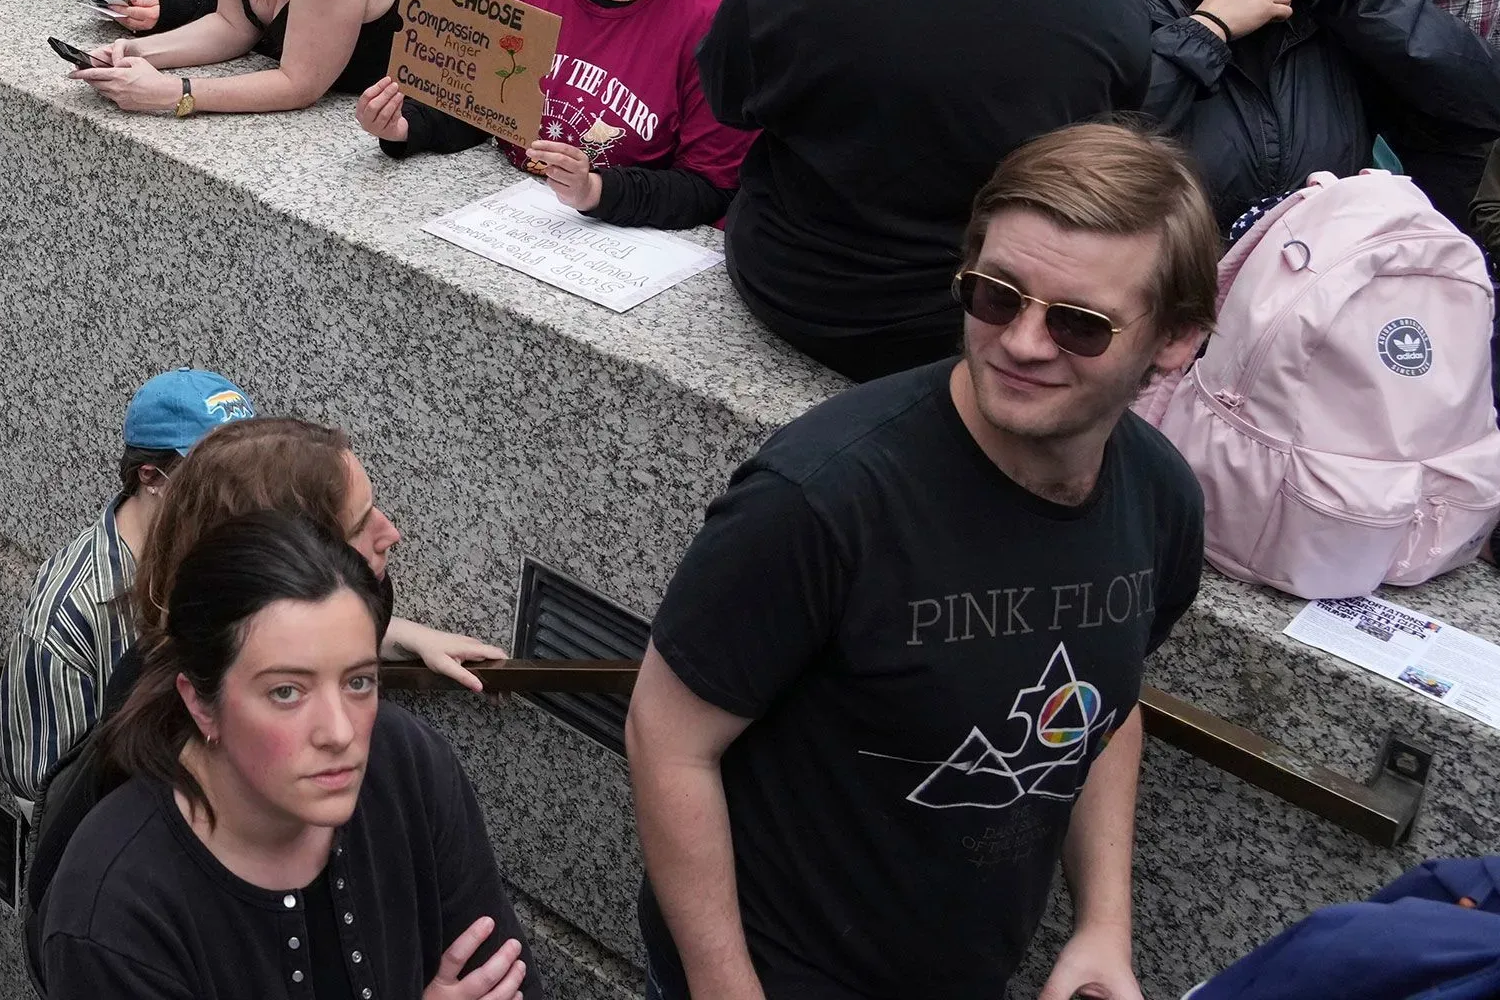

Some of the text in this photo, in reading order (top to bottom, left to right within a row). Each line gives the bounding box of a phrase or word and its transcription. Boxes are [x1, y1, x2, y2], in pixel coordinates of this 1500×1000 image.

[406, 0, 491, 50] Compassion
[404, 28, 478, 81] Presence
[444, 34, 483, 59] Anger
[397, 65, 462, 104] Conscious
[439, 68, 475, 95] Panic
[569, 57, 609, 97] THE
[604, 77, 660, 142] STARS
[1395, 351, 1425, 361] adidas
[906, 586, 1036, 646] PINK
[1315, 601, 1355, 622] TRUMP!
[1359, 614, 1398, 634] DEFEAT
